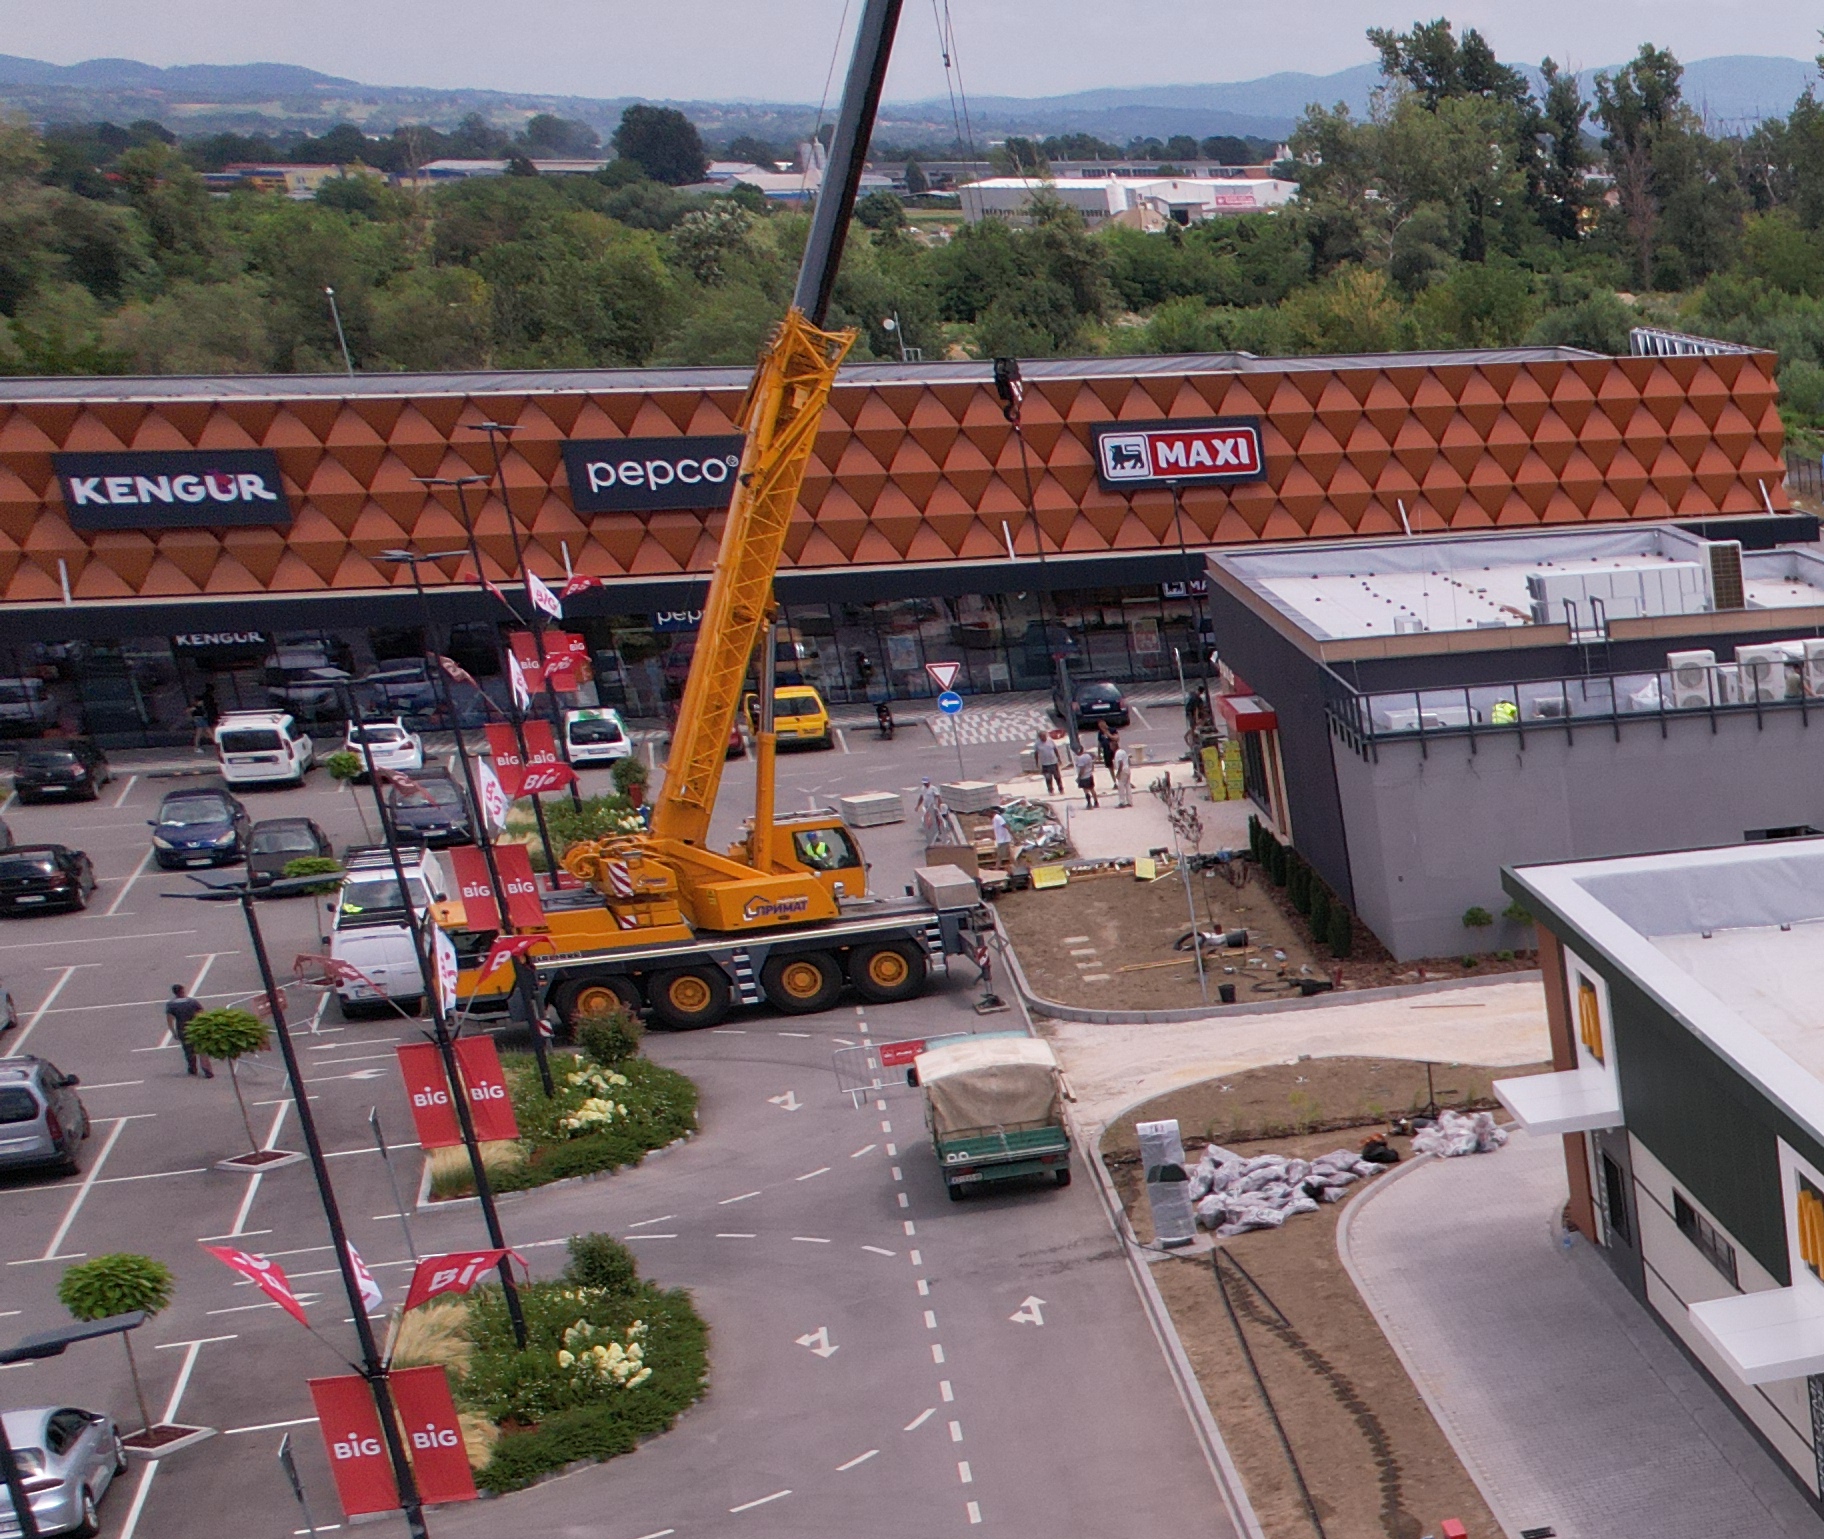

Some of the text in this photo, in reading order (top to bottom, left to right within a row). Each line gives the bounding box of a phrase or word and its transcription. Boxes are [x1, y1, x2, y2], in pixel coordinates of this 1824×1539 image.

[1156, 438, 1251, 468] MAXI
[69, 473, 277, 505] KENGUR
[176, 631, 265, 646] KENGUR
